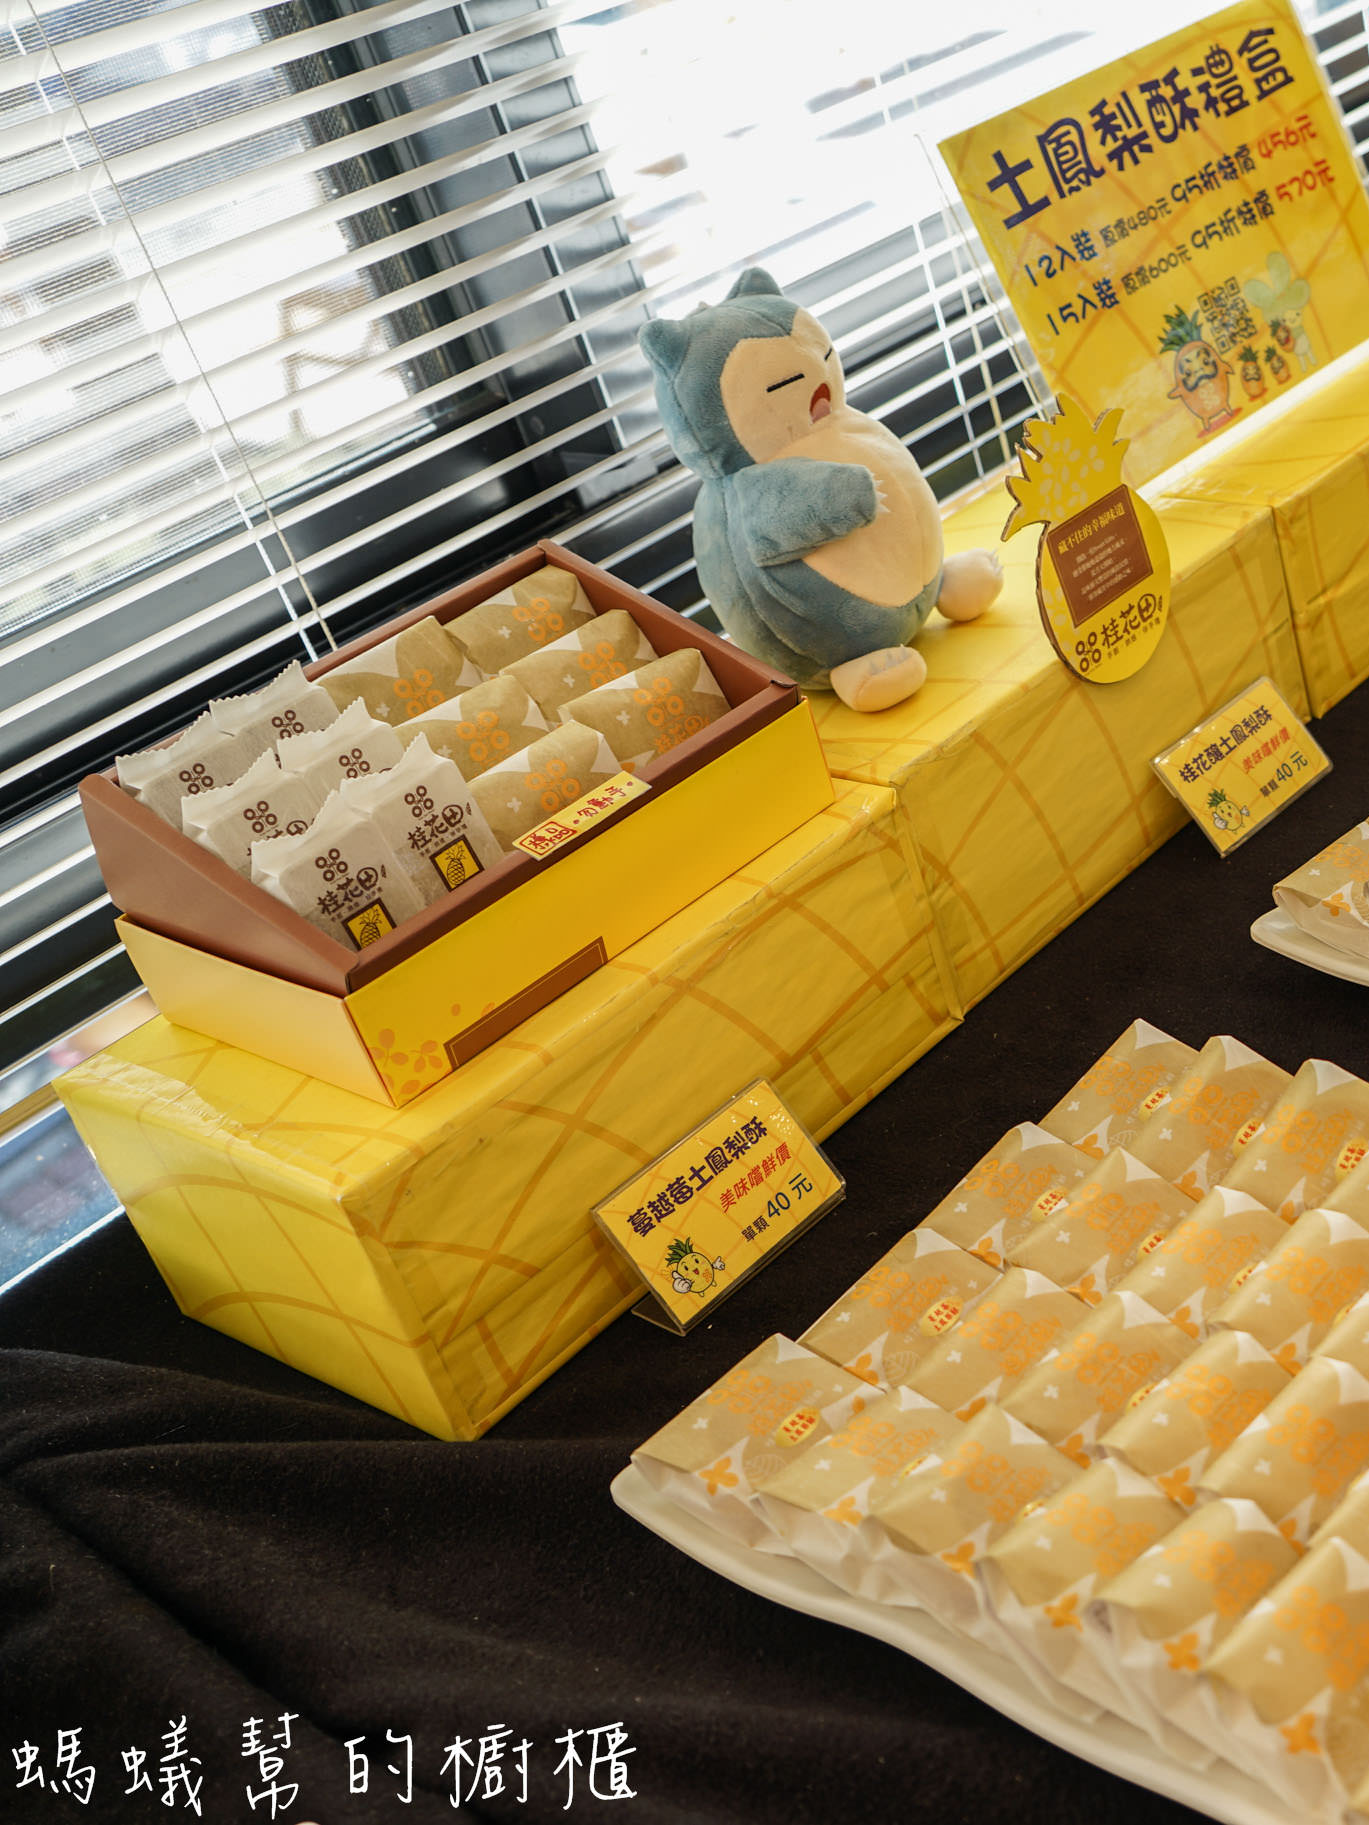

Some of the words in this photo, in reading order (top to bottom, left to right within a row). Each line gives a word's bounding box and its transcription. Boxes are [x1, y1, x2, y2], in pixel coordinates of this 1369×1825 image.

[986, 27, 1295, 230] 土鳳梨酥禮盒
[1025, 229, 1098, 287] 12入裝
[1171, 144, 1256, 204] 95折特價
[1258, 114, 1317, 159] 456元
[1046, 277, 1120, 336] 15入裝
[1191, 189, 1275, 250] 95折特價
[1275, 159, 1335, 203] 570元
[1101, 593, 1156, 648] 桂花田
[1178, 705, 1273, 783] 桂花釀土鳳梨酥
[1276, 763, 1293, 782] 40
[1290, 751, 1308, 771] 元
[407, 804, 464, 851] 桂花田
[577, 786, 626, 817] 勿動手
[317, 866, 379, 917] 桂花田
[627, 1116, 767, 1237] 蔓越莓土鳳梨酥
[720, 1142, 792, 1213] 美味嚐鮮價
[741, 1215, 770, 1242] 單顆
[766, 1191, 792, 1219] 40
[788, 1172, 813, 1200] 元
